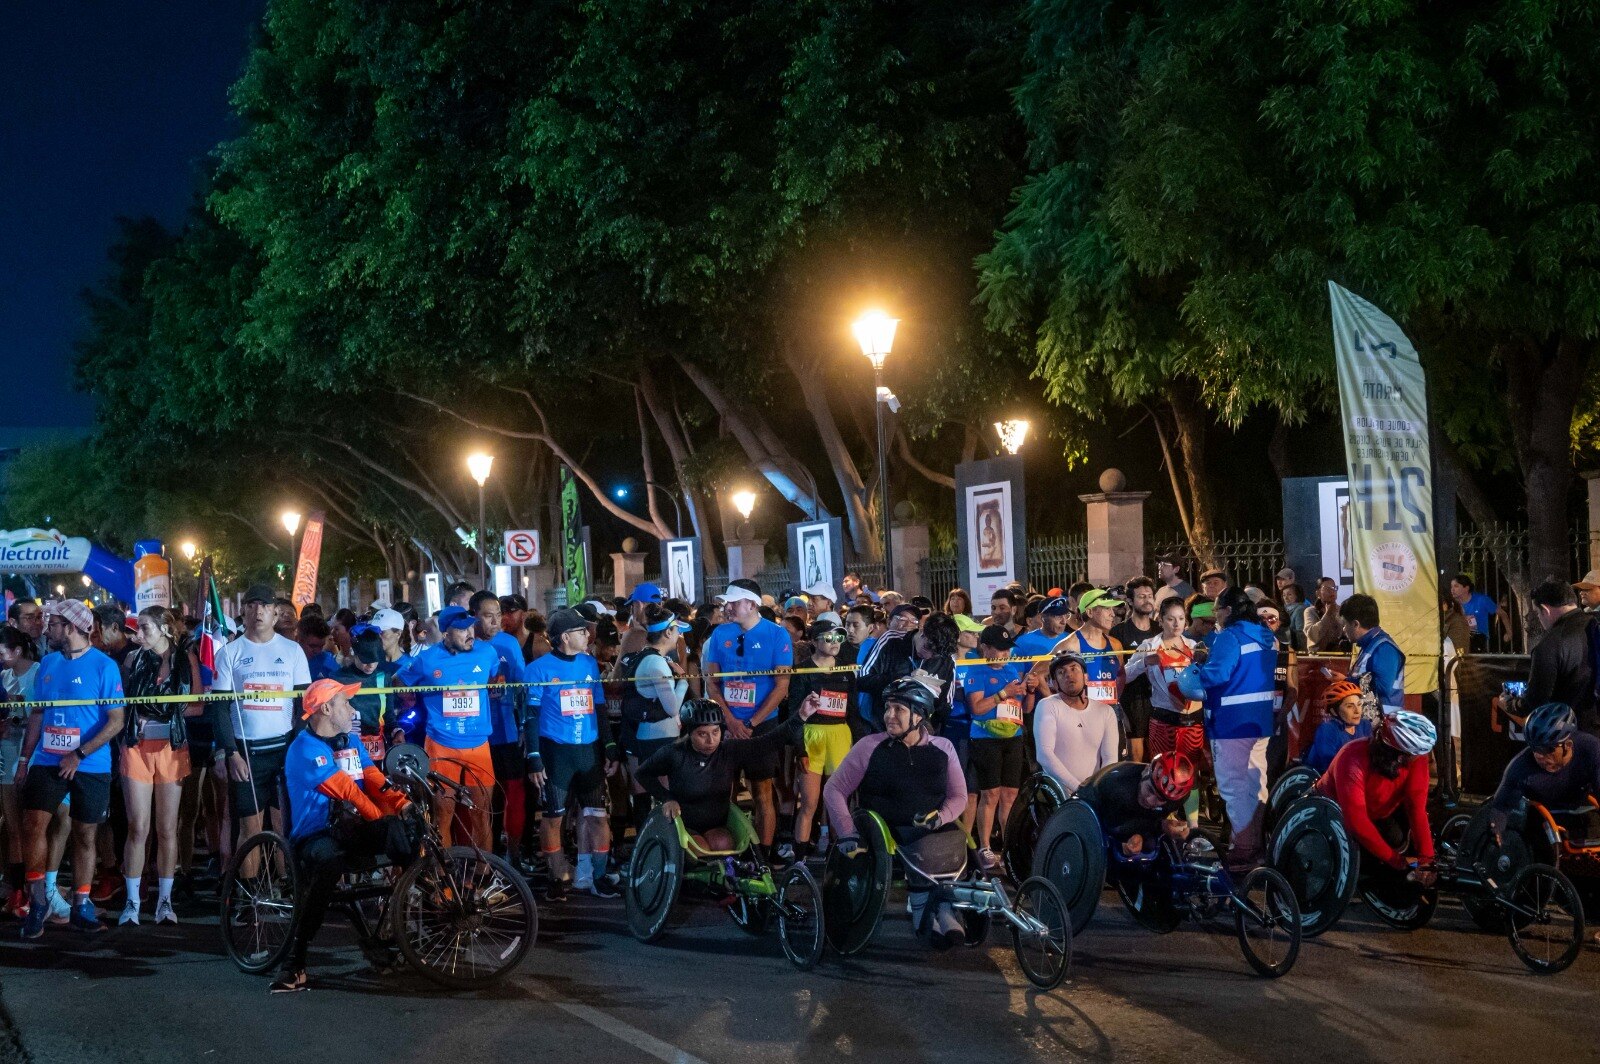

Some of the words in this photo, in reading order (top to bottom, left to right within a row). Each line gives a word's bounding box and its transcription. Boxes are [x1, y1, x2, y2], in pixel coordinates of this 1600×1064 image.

[0, 546, 71, 561] lectrolit
[1096, 669, 1112, 680] Joe
[1274, 667, 1287, 675] ER
[729, 687, 749, 700] 2273
[452, 697, 473, 709] 3992
[50, 733, 72, 748] 2592
